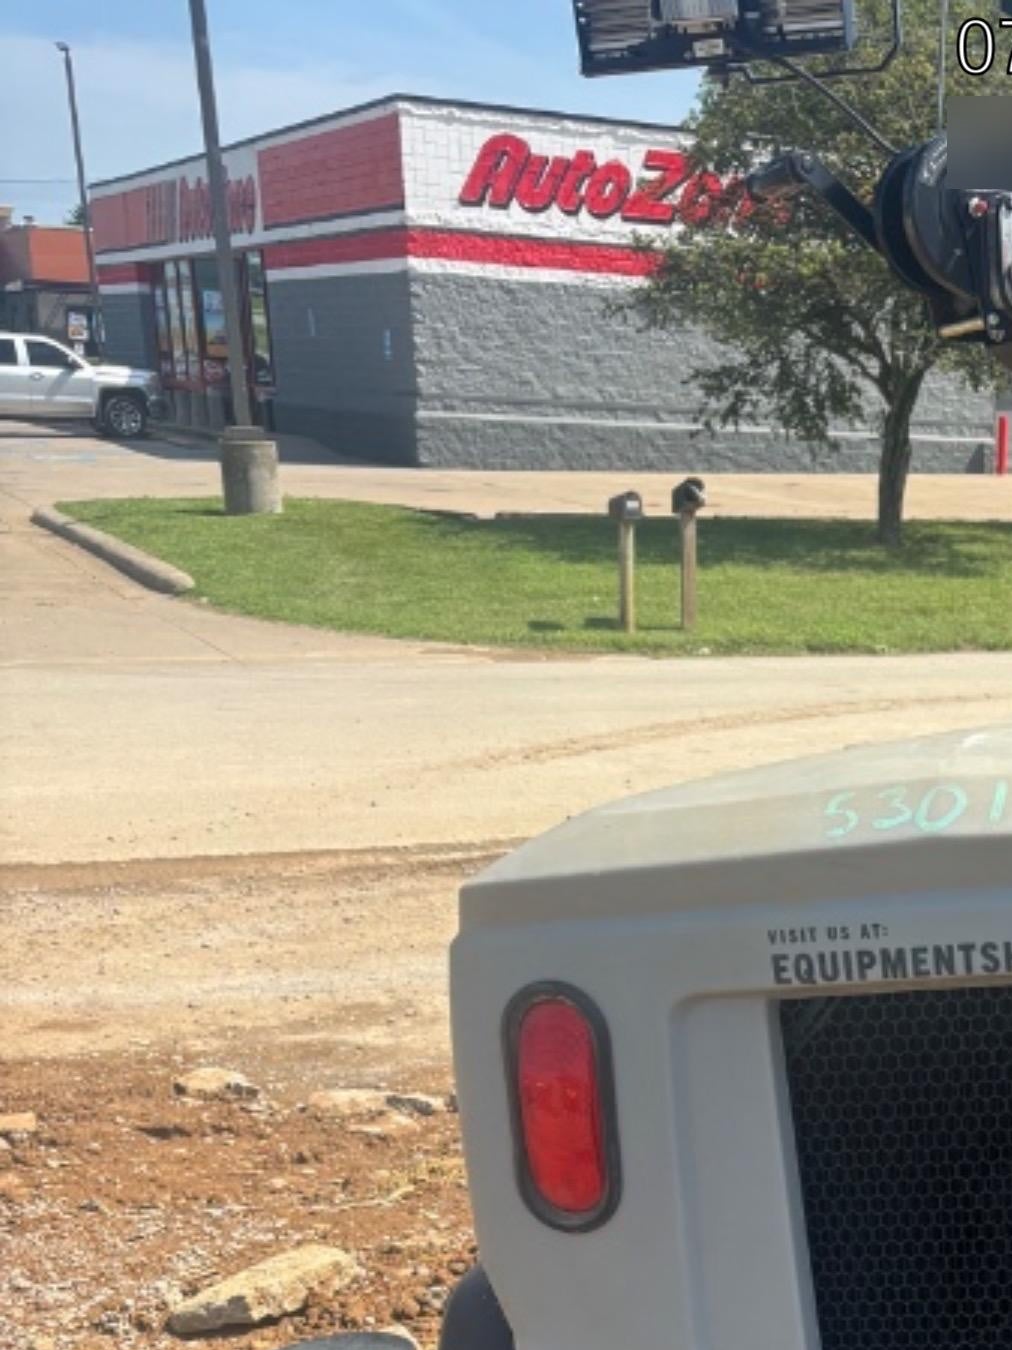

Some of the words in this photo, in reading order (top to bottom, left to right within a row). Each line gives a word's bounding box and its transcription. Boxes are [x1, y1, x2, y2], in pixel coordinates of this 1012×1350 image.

[767, 926, 817, 945] VISIT
[826, 925, 850, 942] US
[860, 923, 889, 940] AT:
